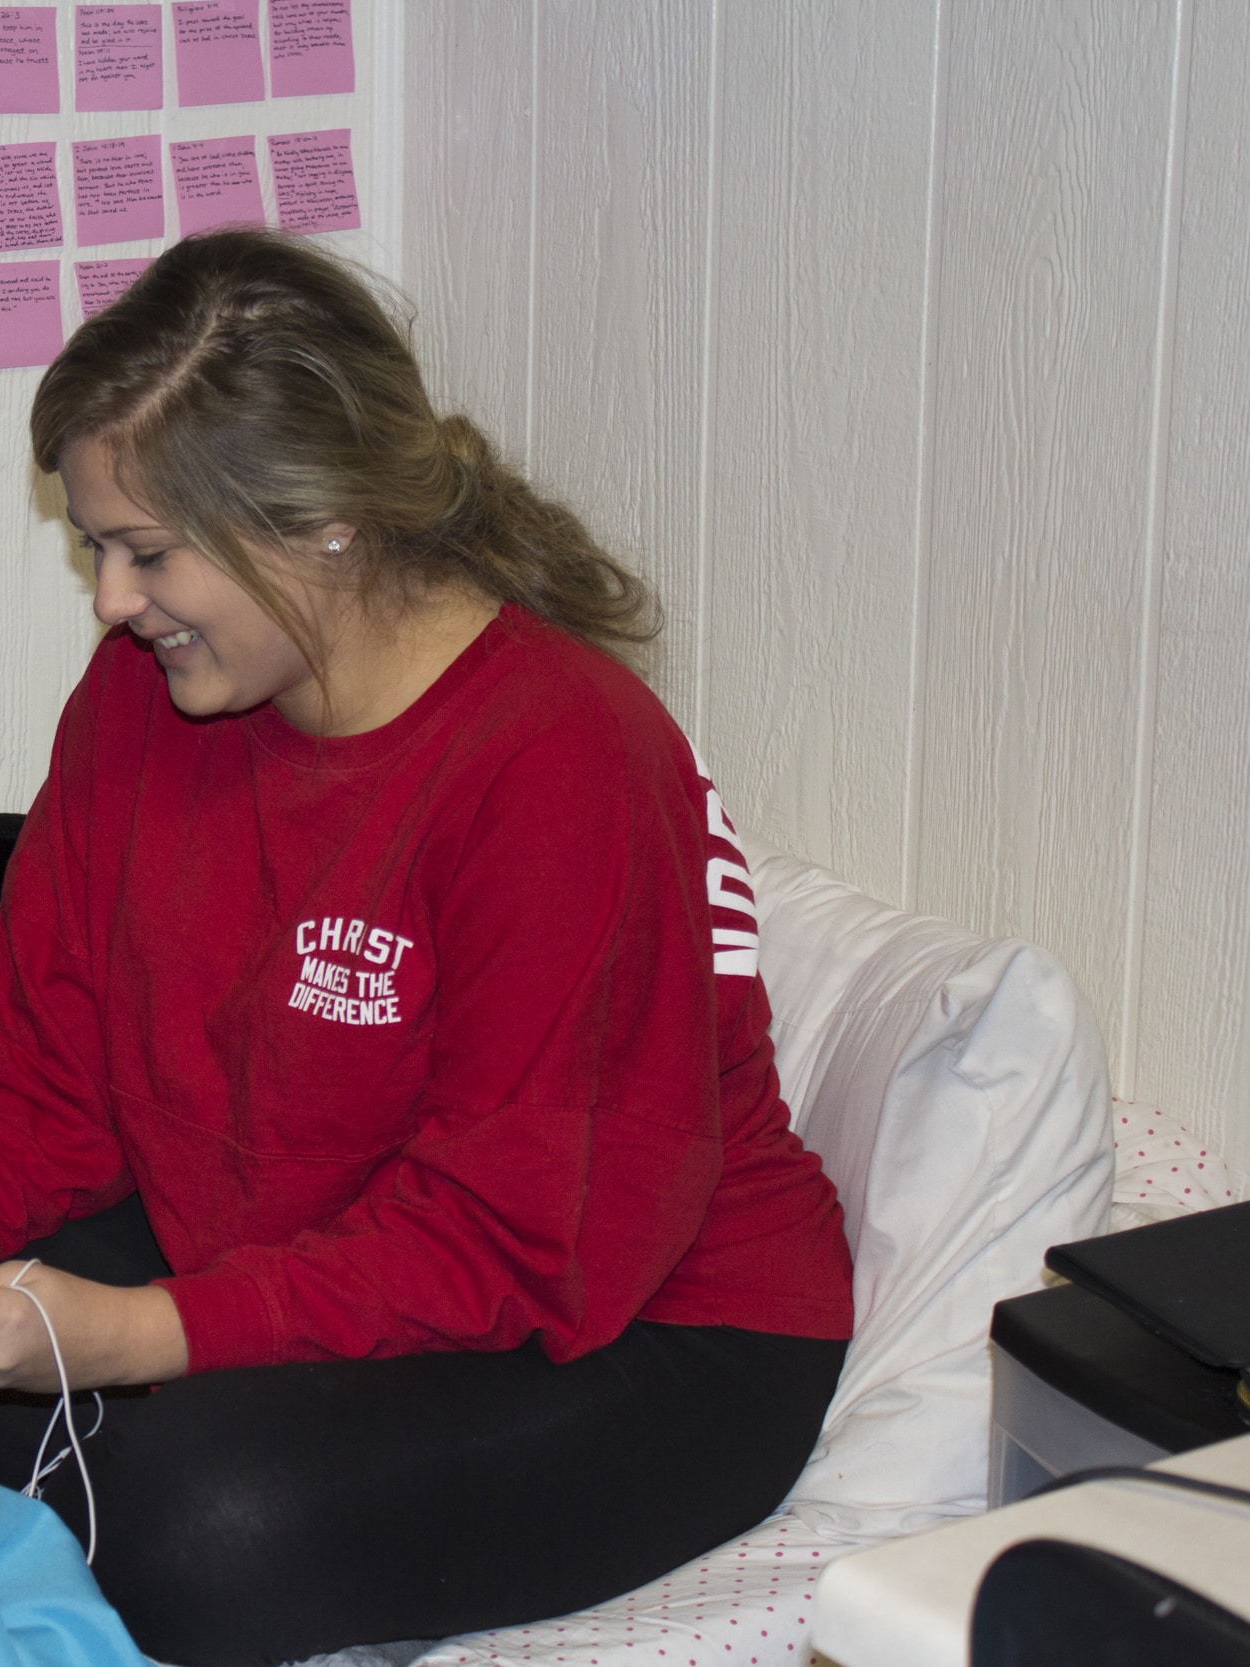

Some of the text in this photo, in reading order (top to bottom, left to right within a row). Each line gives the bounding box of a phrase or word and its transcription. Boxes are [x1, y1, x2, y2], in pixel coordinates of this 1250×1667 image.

[0, 10, 20, 20] 26:3
[35, 23, 44, 32] in
[0, 47, 26, 56] stayed
[300, 955, 396, 998] MAKES THE
[288, 982, 402, 1025] DIFFERENCE
